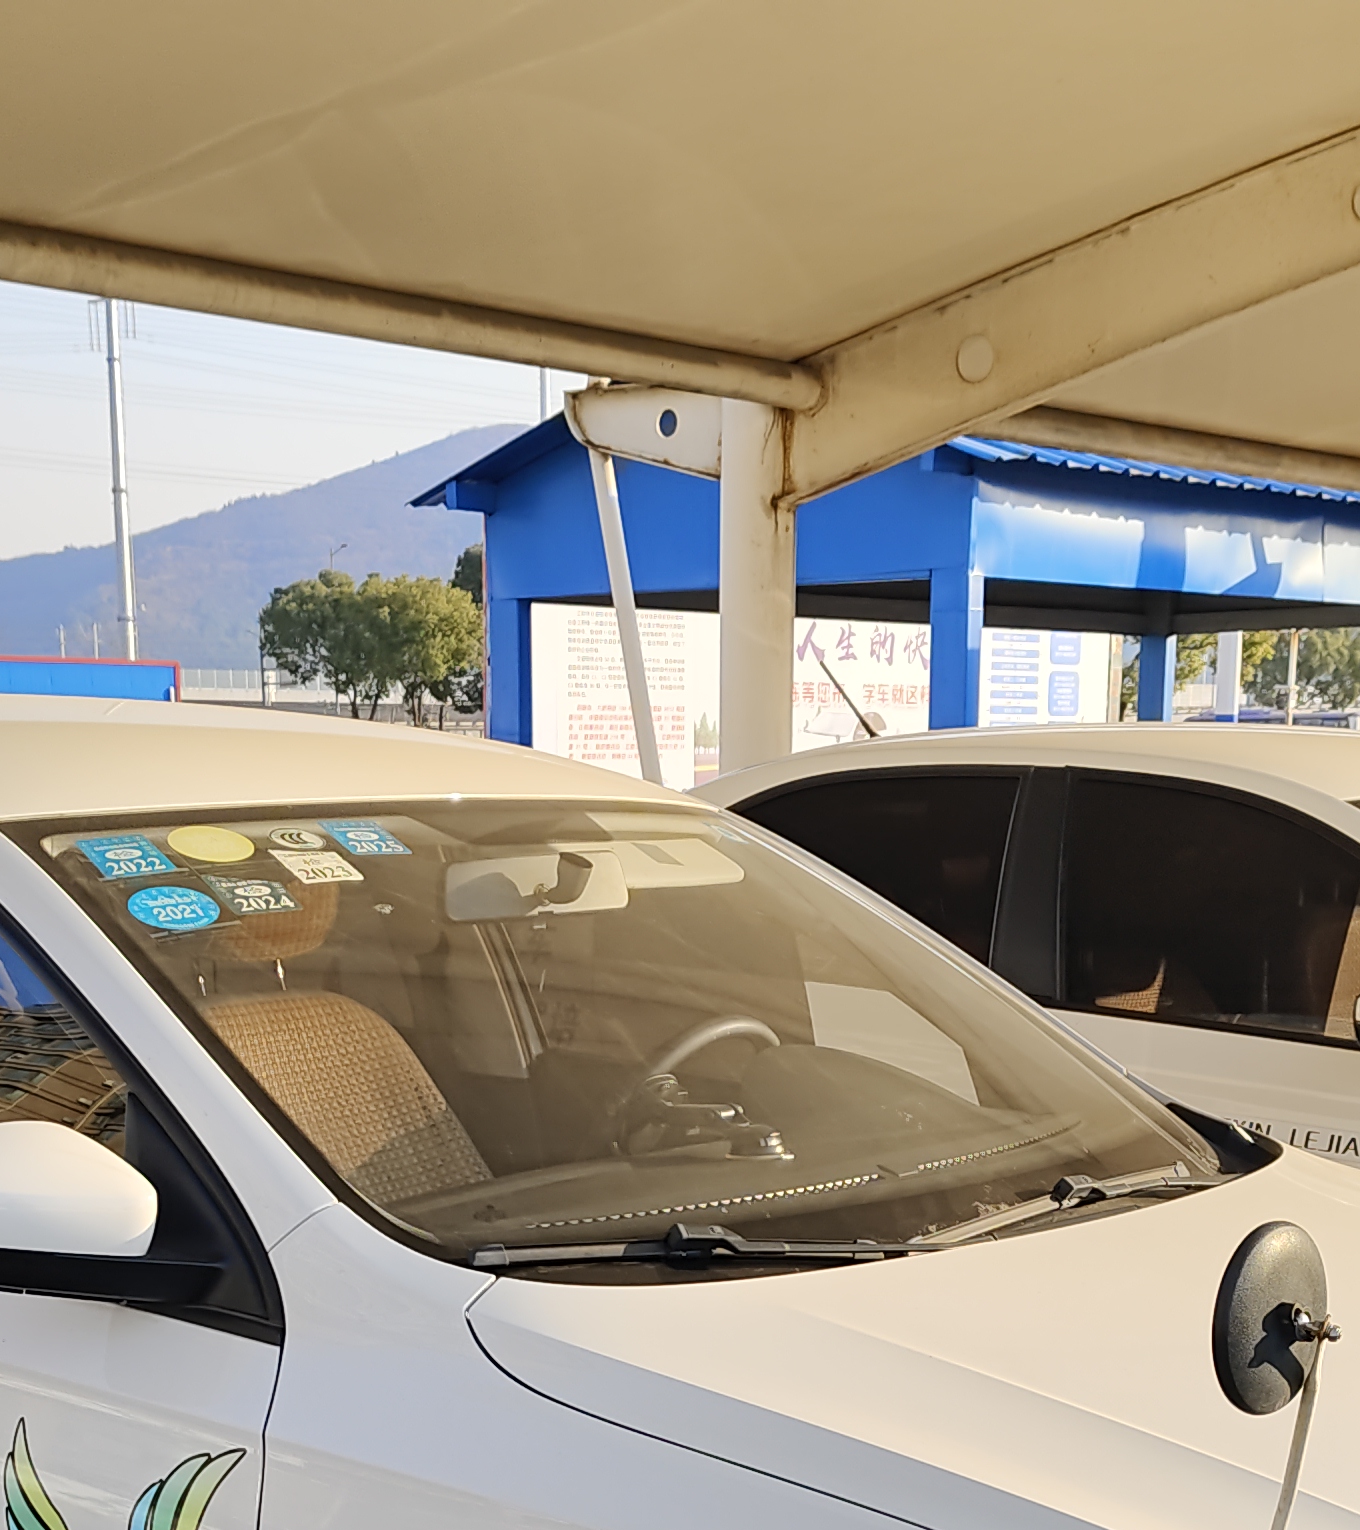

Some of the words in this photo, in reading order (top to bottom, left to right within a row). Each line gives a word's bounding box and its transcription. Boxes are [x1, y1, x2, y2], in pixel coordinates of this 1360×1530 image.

[796, 621, 929, 670] 人生的快
[349, 841, 404, 853] 2025
[105, 857, 166, 876] 2022
[298, 866, 353, 880] 2023
[234, 895, 295, 912] 2024
[152, 904, 205, 922] 2021
[1290, 1128, 1360, 1157] LEJIA
